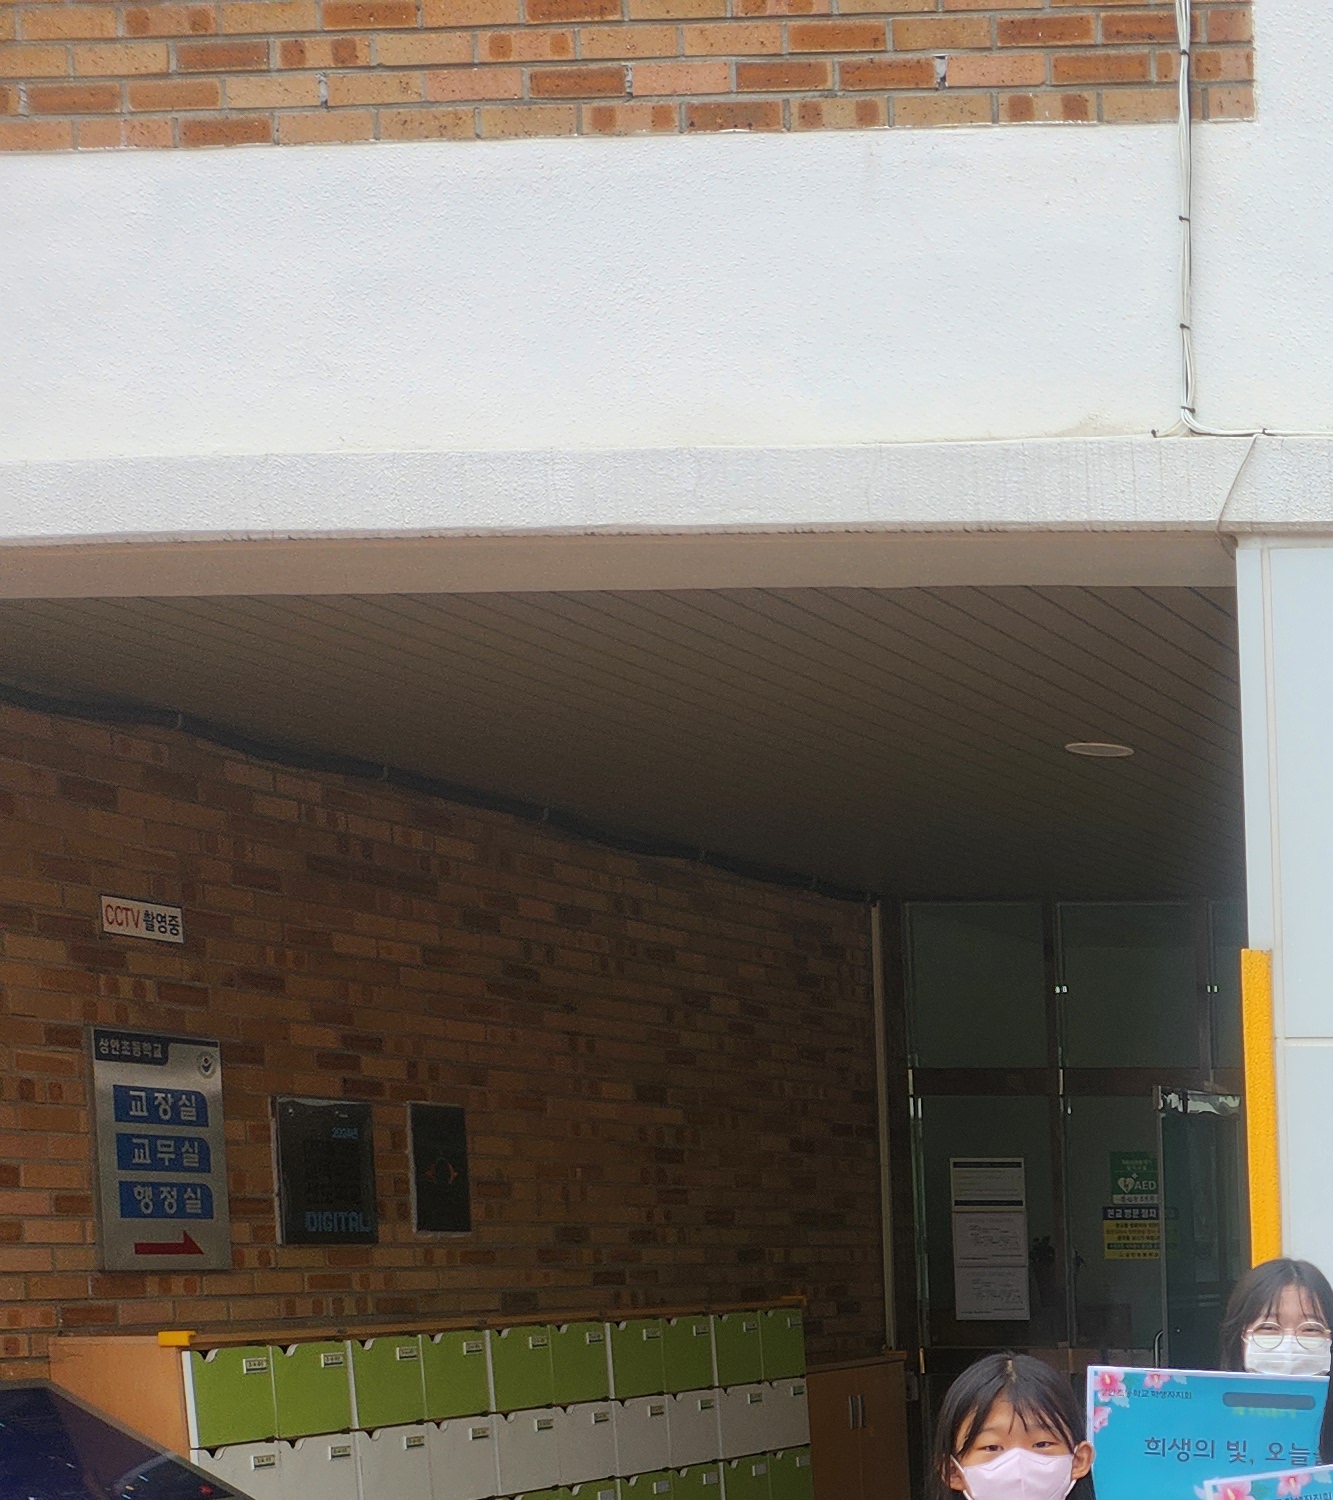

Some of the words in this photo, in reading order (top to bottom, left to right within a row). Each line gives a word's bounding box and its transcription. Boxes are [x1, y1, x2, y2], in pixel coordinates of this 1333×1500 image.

[105, 904, 140, 929] CCTV
[143, 909, 180, 936] 촬영중
[98, 1037, 163, 1059] 상안초등학교
[129, 1090, 197, 1121] 교장실
[131, 1138, 200, 1168] 교무실
[133, 1184, 202, 1214] 행정실
[1134, 1180, 1157, 1190] AED
[304, 1211, 372, 1233] DIGITAL
[1143, 1436, 1215, 1463] 희생의
[1226, 1440, 1254, 1466] 빛,
